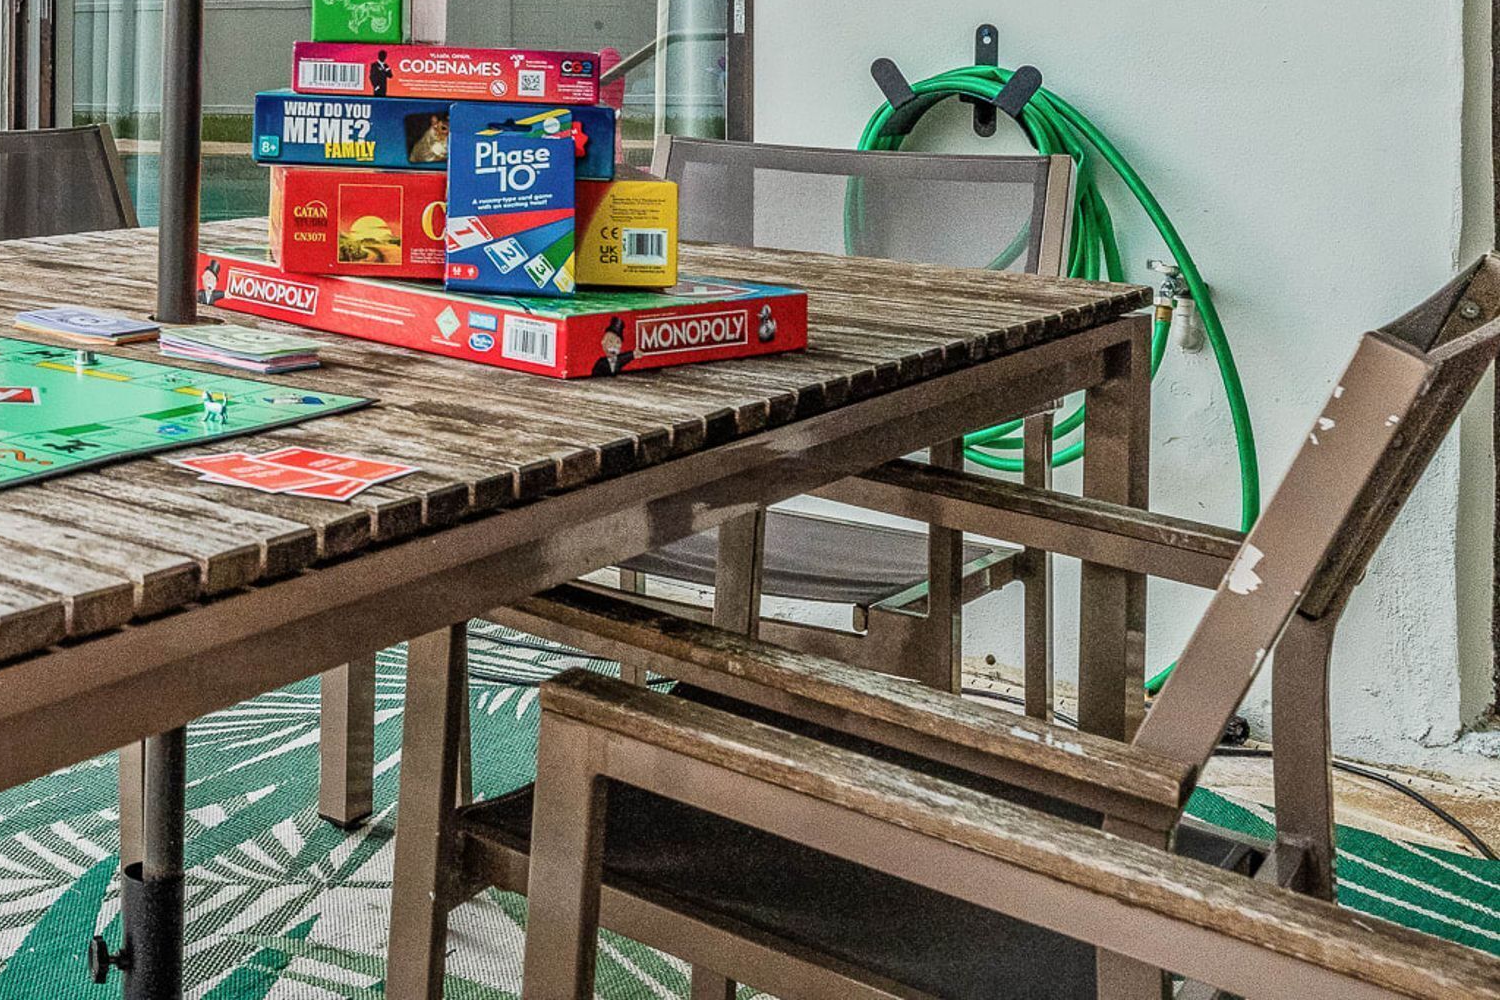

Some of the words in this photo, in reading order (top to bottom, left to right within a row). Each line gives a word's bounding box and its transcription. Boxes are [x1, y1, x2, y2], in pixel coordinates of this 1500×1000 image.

[399, 59, 501, 76] CODENAMES
[284, 101, 323, 117] WHAT
[324, 102, 343, 118] DO
[345, 103, 372, 119] YOU
[283, 117, 370, 144] MEME?
[261, 141, 276, 153] 8+
[325, 141, 377, 159] FAMILY
[475, 141, 550, 168] Phase
[498, 164, 536, 192] 10
[294, 206, 328, 218] CATAN
[294, 232, 327, 242] CN3071
[230, 277, 315, 308] MONOPOLY
[641, 316, 744, 350] MONOPOLY
